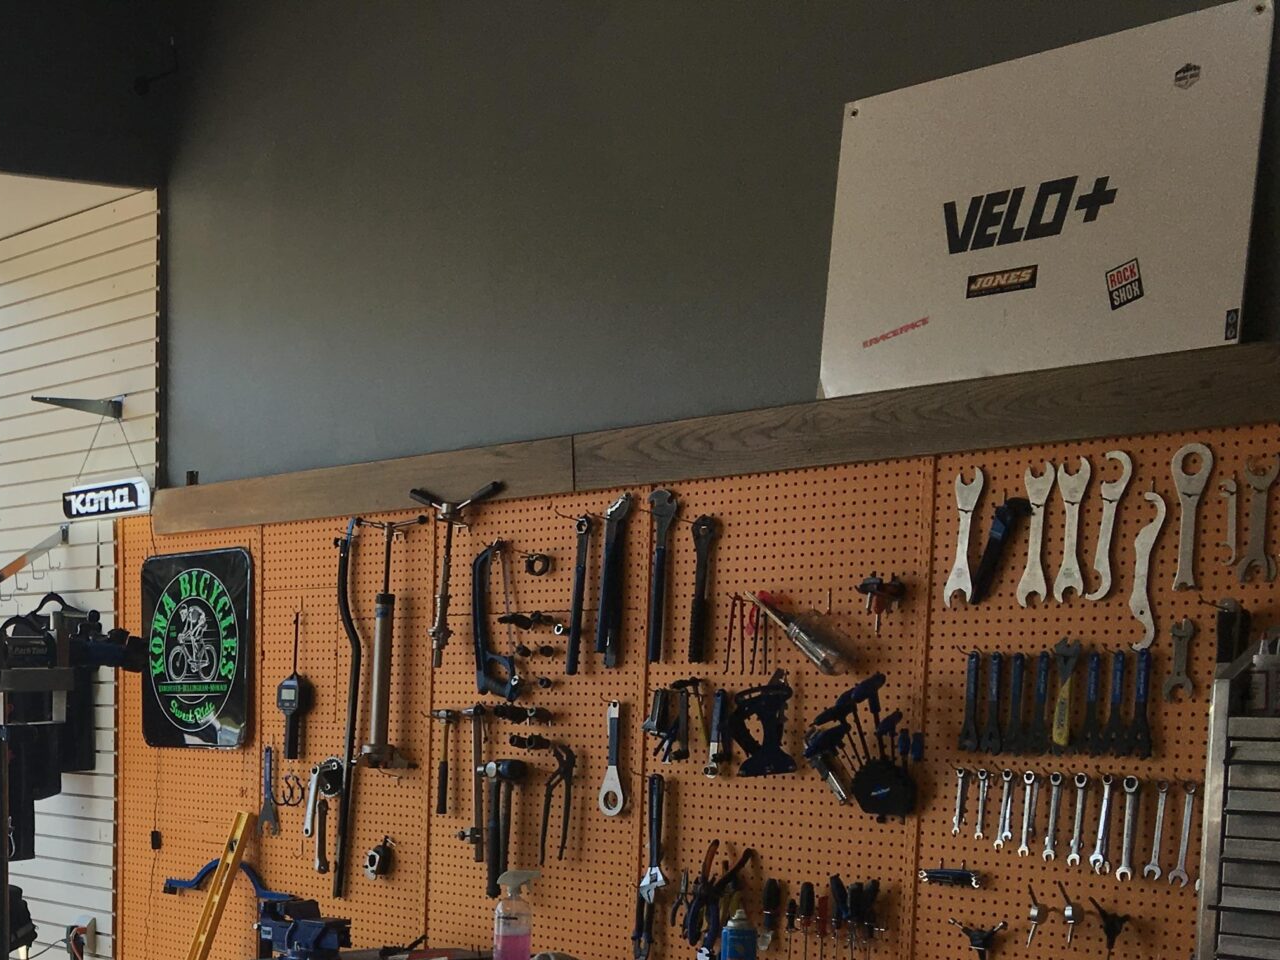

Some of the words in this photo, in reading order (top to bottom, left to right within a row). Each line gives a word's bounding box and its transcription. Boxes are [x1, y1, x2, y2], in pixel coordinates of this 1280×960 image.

[943, 174, 1119, 255] VELO+
[970, 269, 1033, 290] JONES
[1110, 263, 1136, 288] ROCK
[1111, 280, 1141, 306] SHOX
[152, 593, 176, 677] KONA
[179, 570, 236, 680] BICYCLES
